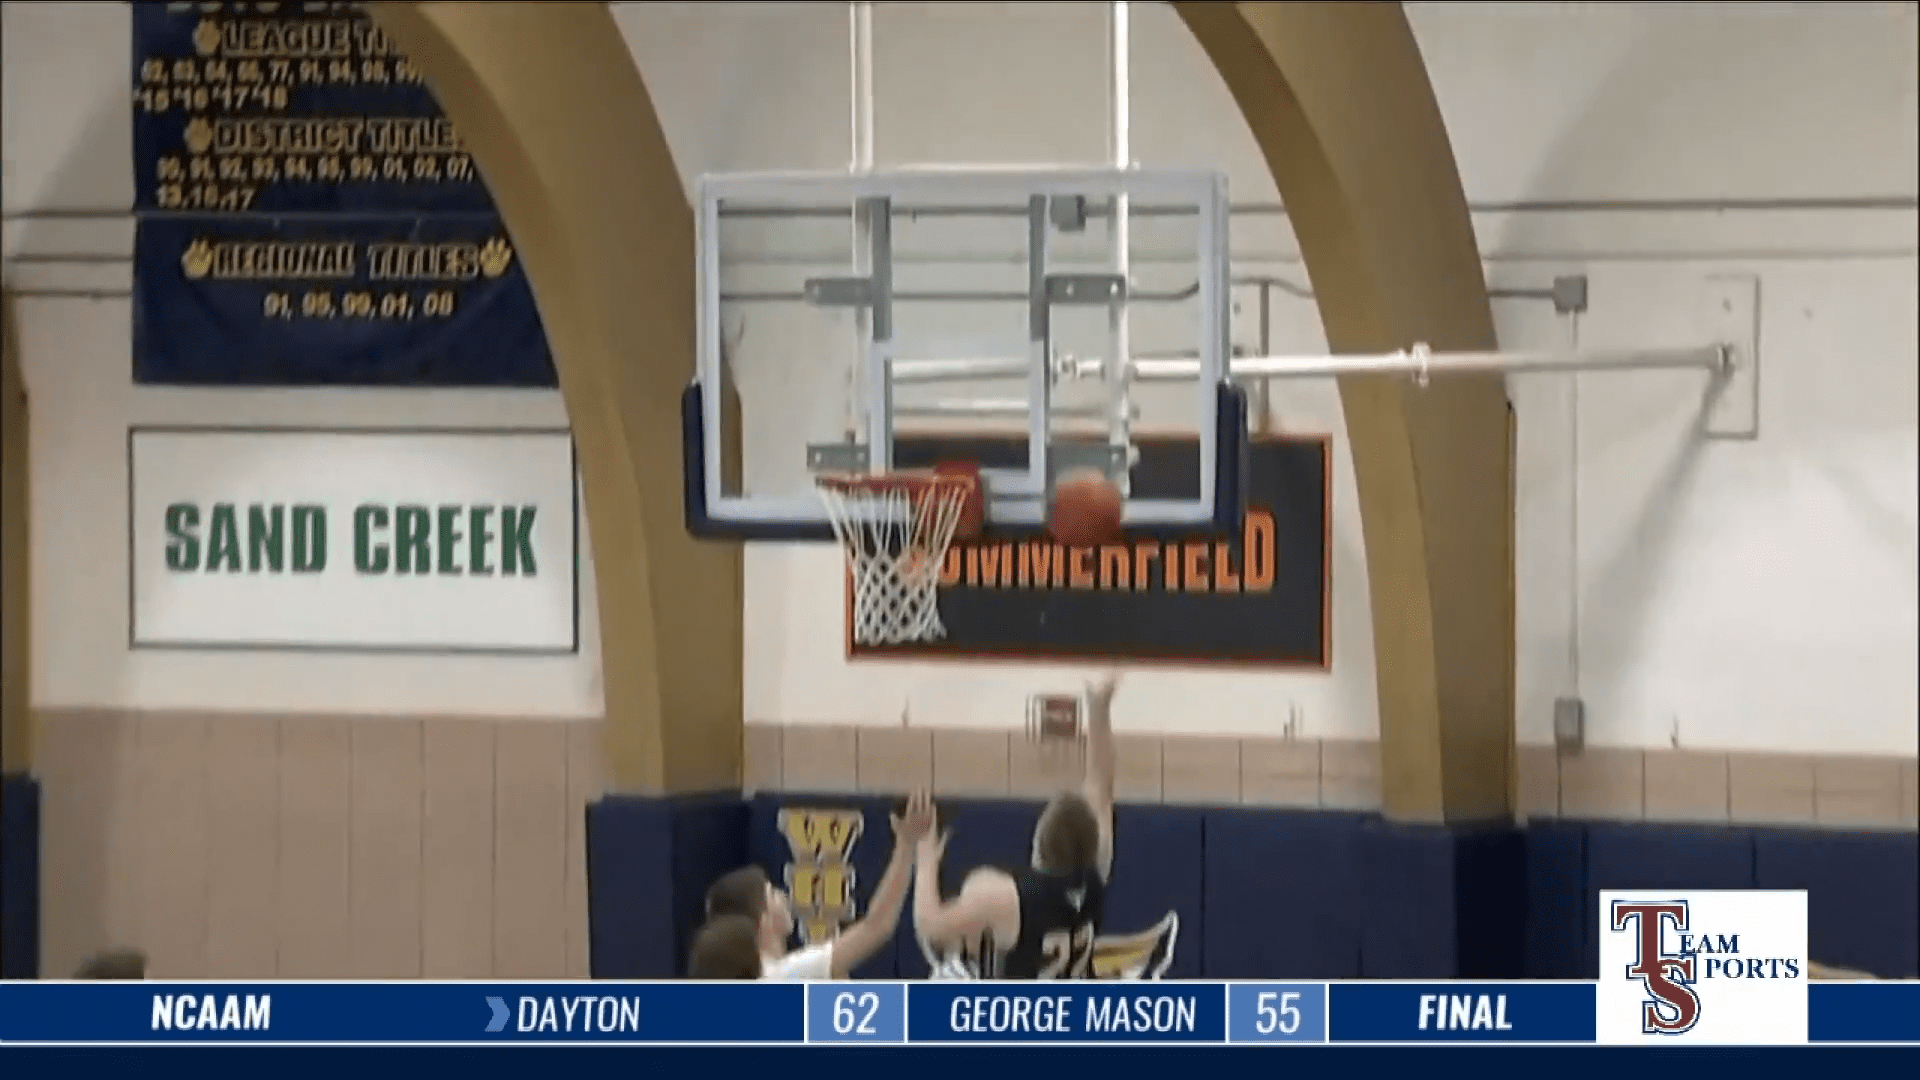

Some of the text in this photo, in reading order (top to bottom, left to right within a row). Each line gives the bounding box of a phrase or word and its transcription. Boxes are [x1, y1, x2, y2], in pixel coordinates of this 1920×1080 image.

[222, 20, 351, 56] LEAGUE
[214, 118, 461, 154] DISTRICT TITLE
[213, 242, 479, 280] REGIONAL TITLES
[165, 502, 538, 576] SAND CREEK
